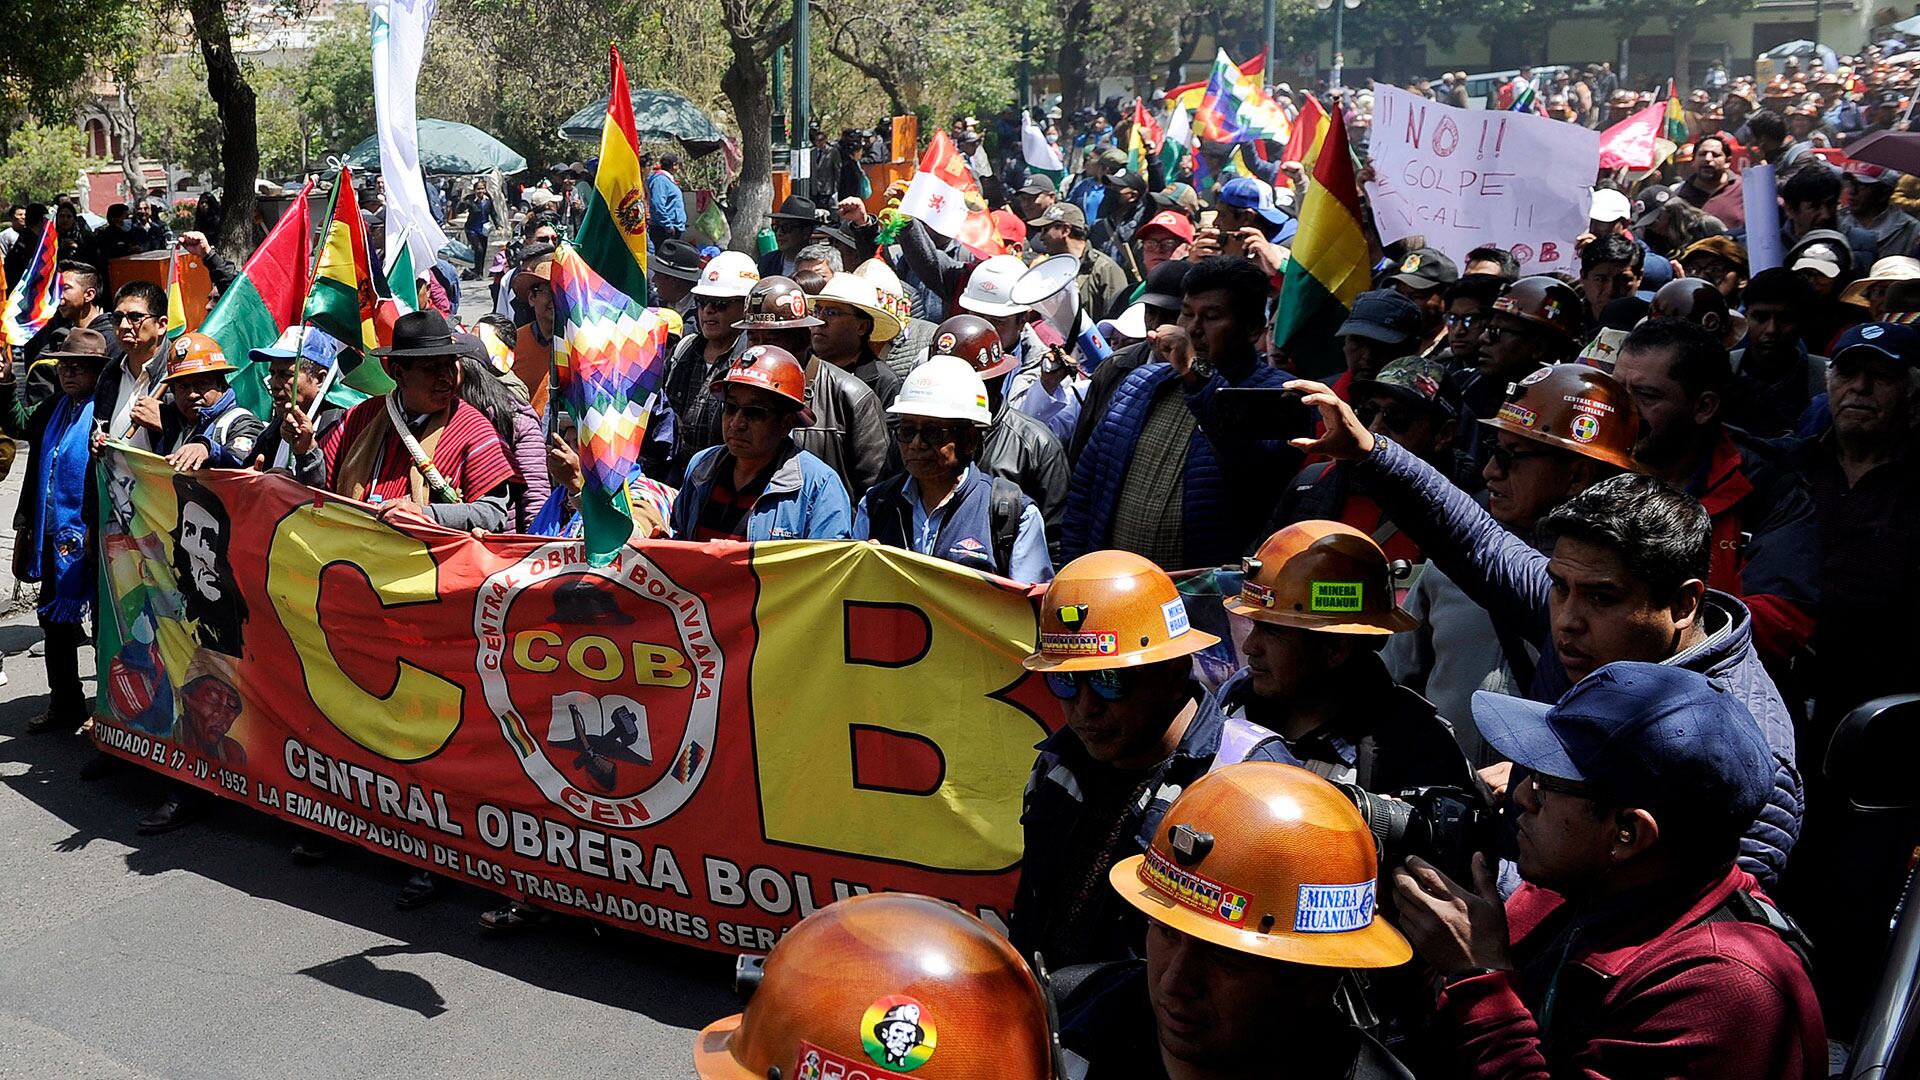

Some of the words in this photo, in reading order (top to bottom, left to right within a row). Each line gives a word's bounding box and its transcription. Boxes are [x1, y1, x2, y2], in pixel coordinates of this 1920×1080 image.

[1405, 102, 1459, 157] NO
[1402, 159, 1516, 197] GOLPE
[1315, 597, 1359, 608] HUANUNI
[1318, 585, 1357, 597] MINERA
[481, 574, 520, 671] CENTRAL
[628, 563, 717, 701] BOLIVIANA
[512, 630, 693, 689] COB
[285, 739, 463, 836] CENTRAL
[477, 804, 690, 895] OBRERA
[559, 786, 652, 826] CEN
[94, 722, 151, 760] FUNDADO
[151, 743, 167, 765] EL
[170, 750, 186, 771] 17
[195, 759, 209, 780] IV
[219, 769, 249, 796] 1952
[258, 783, 280, 809] LA
[285, 792, 428, 860] EMANCIPACIÓN
[432, 844, 460, 871] DE
[465, 854, 506, 885] LOS
[511, 869, 710, 940] TRABAJADORES
[718, 922, 785, 950] SER
[1299, 908, 1359, 928] HUANUNI
[1306, 889, 1357, 908] MINERA
